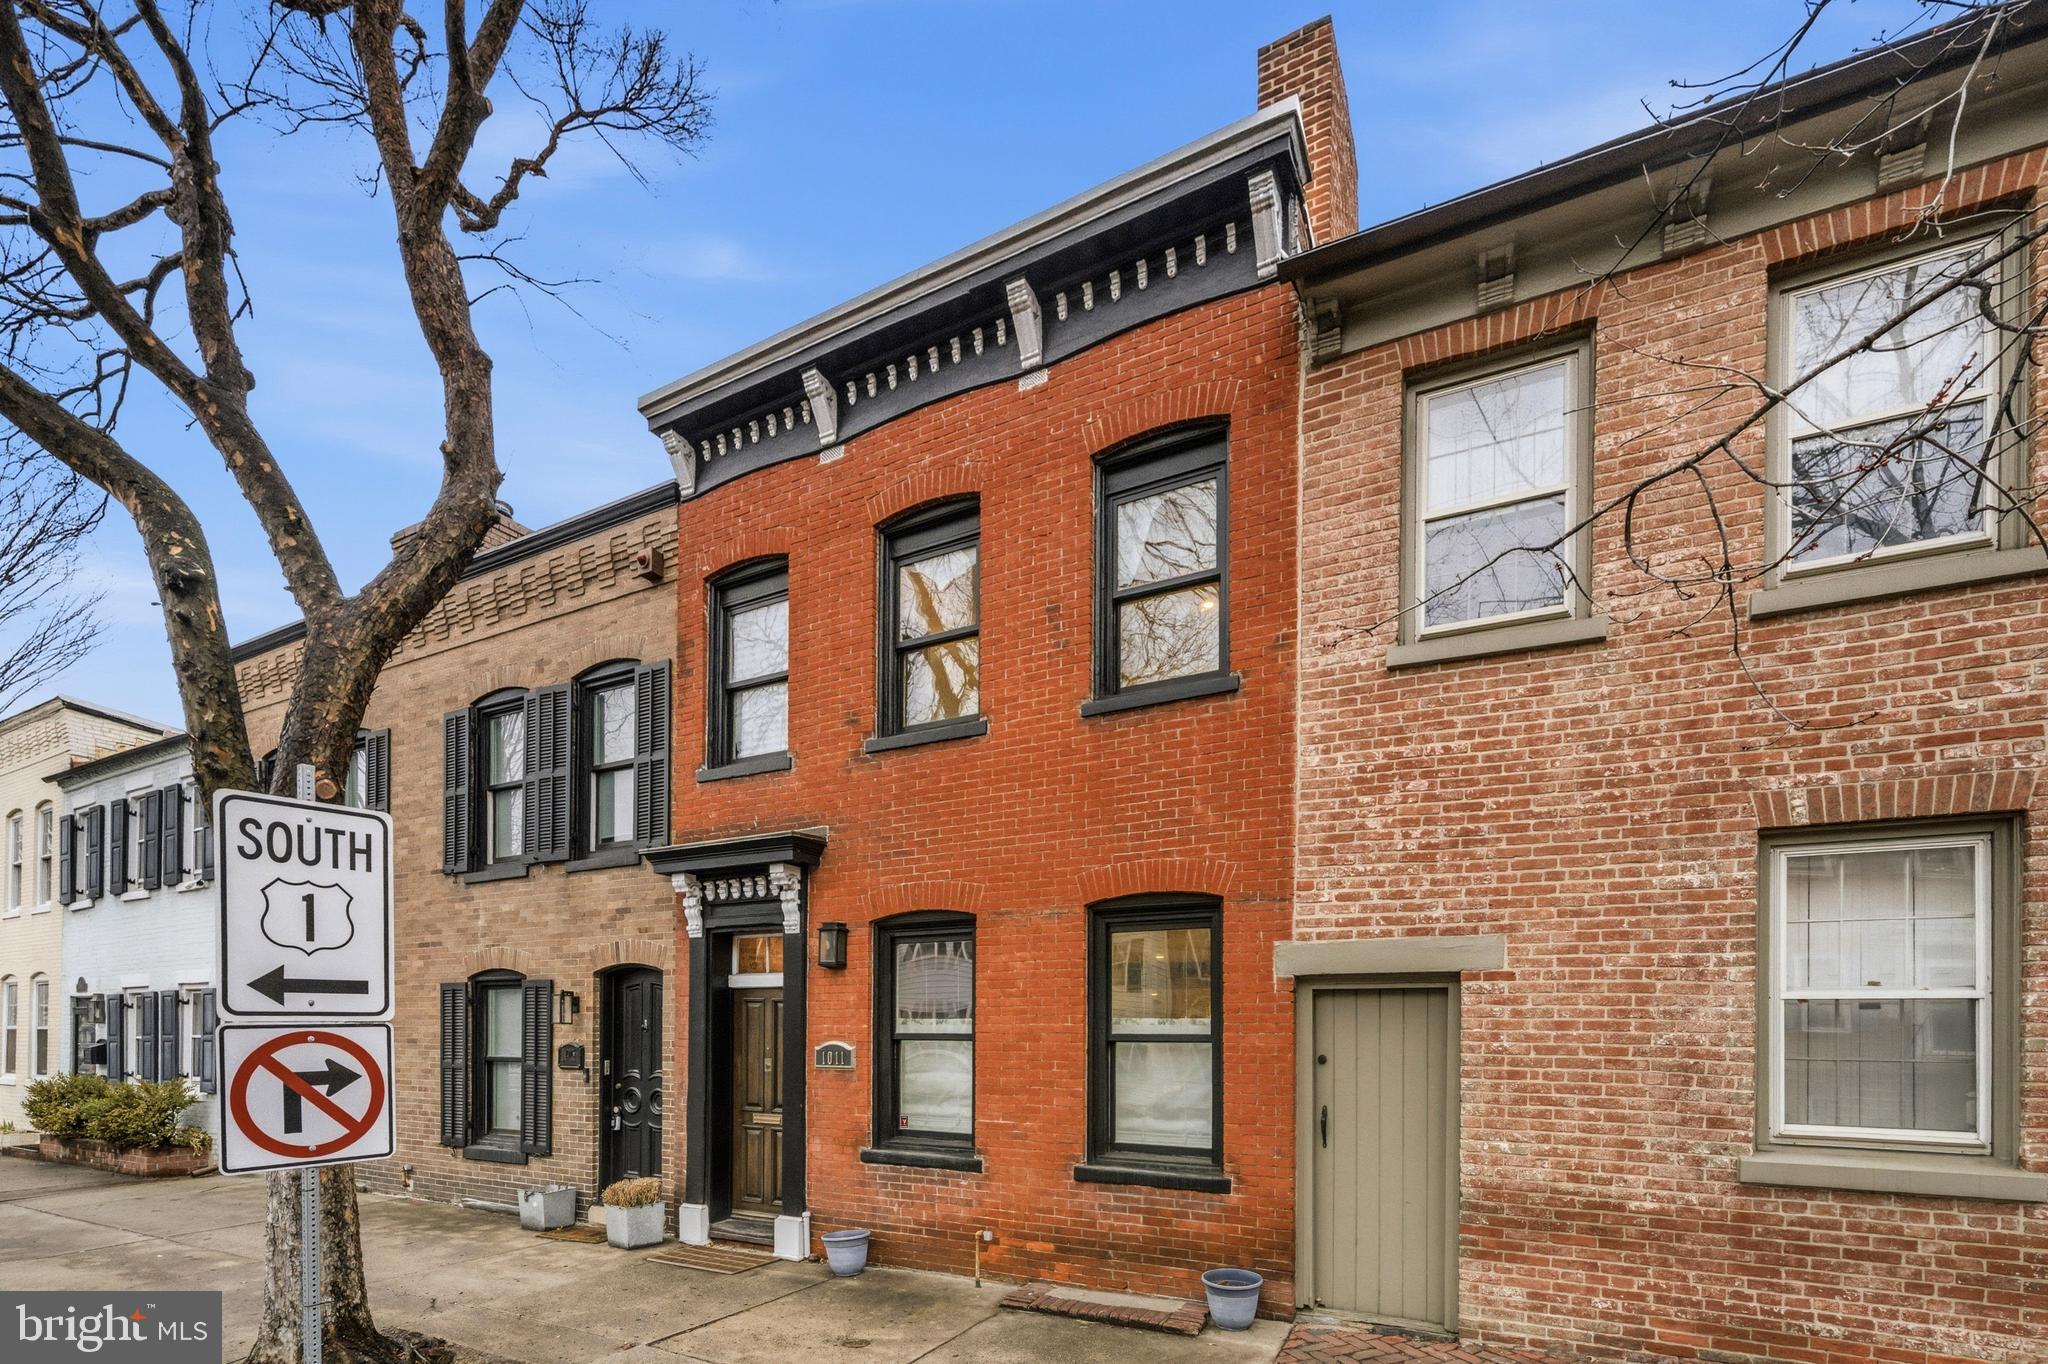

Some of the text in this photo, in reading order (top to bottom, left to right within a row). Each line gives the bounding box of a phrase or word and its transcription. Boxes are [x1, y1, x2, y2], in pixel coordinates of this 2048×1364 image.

[237, 817, 372, 872] SOUTH
[302, 893, 315, 942] 1
[822, 1051, 845, 1065] 1011
